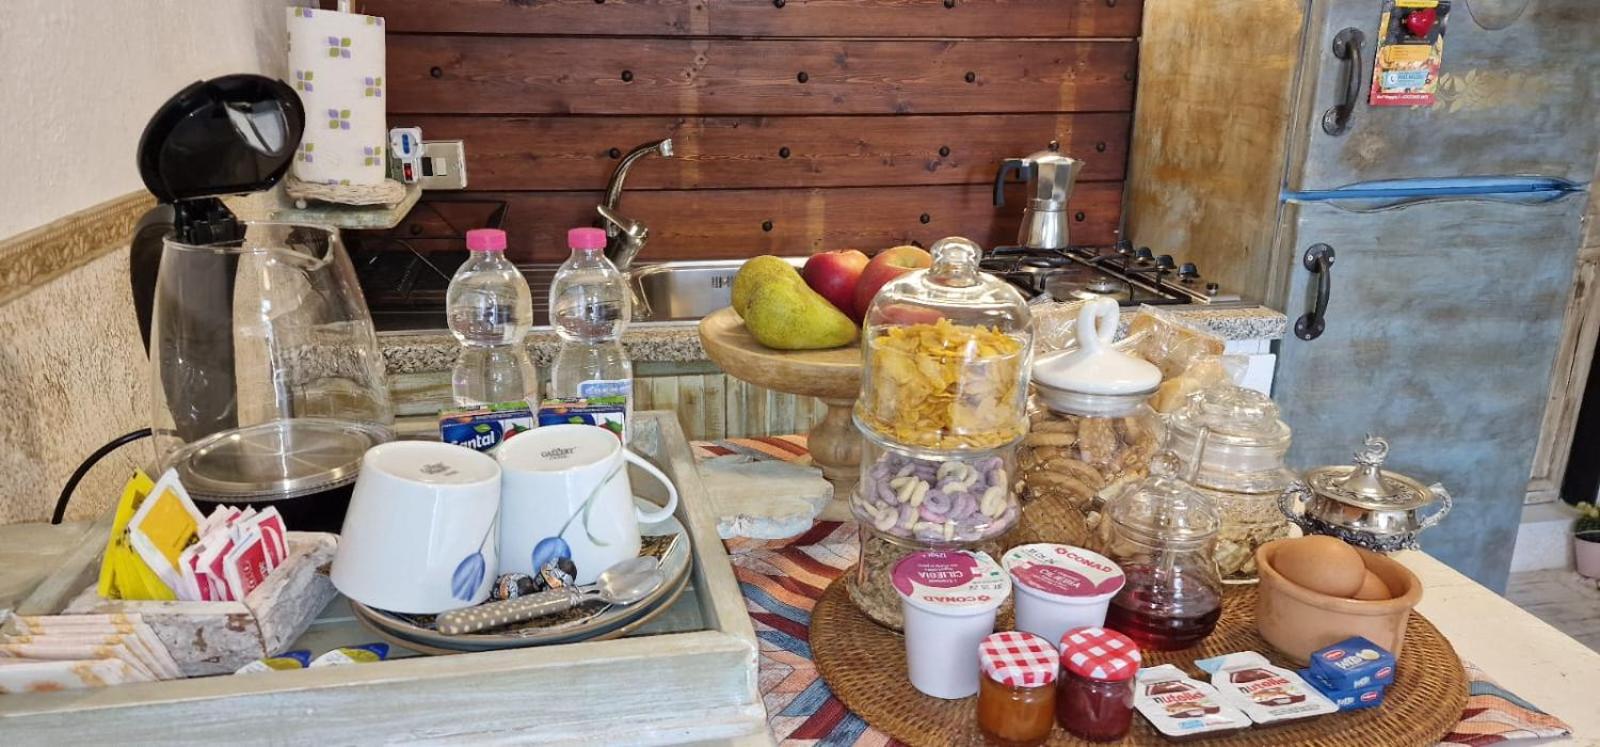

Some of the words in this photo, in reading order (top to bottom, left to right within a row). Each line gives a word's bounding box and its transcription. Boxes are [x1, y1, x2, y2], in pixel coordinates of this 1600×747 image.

[1066, 552, 1113, 574] CONAD
[1238, 677, 1292, 694] nutella
[1153, 690, 1206, 705] nutella
